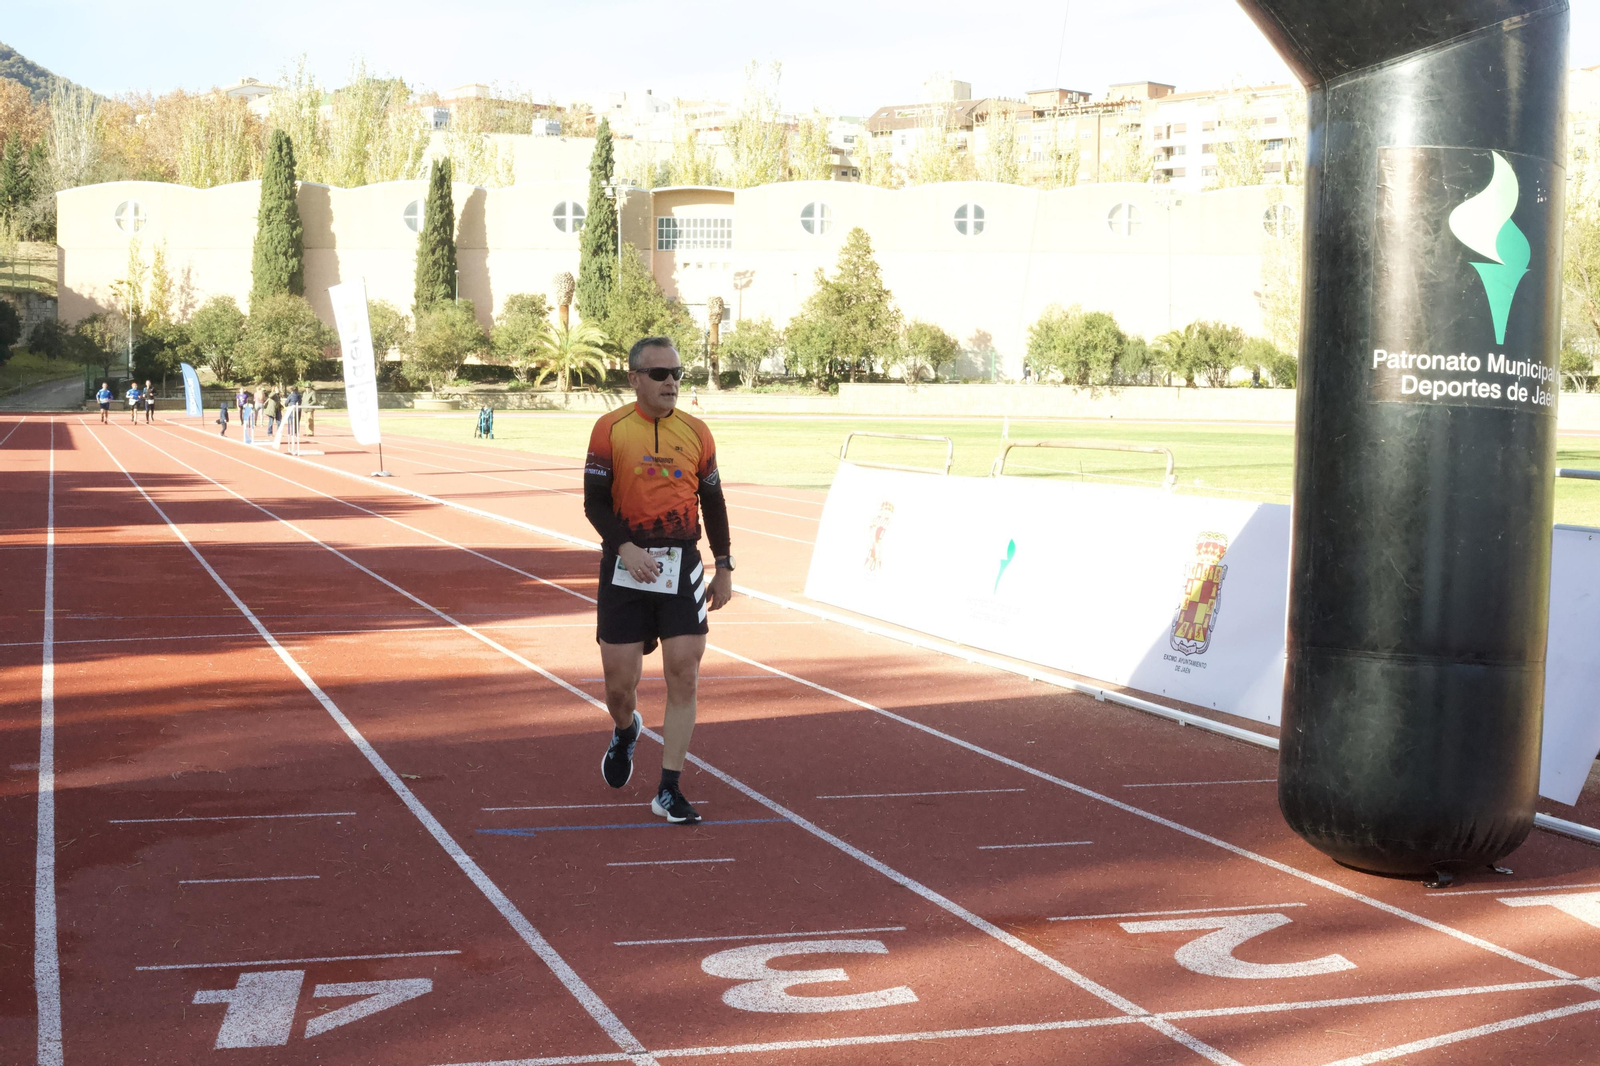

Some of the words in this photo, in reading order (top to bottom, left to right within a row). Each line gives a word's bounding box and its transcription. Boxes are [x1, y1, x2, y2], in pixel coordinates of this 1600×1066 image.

[1373, 349, 1481, 372] Patronato
[1487, 352, 1556, 385] Municipal
[1401, 375, 1501, 401] Deportes
[1507, 382, 1528, 402] de
[1531, 385, 1556, 407] Jaén
[701, 938, 919, 1014] 3
[1119, 912, 1358, 980] 2
[192, 969, 433, 1050] 4
